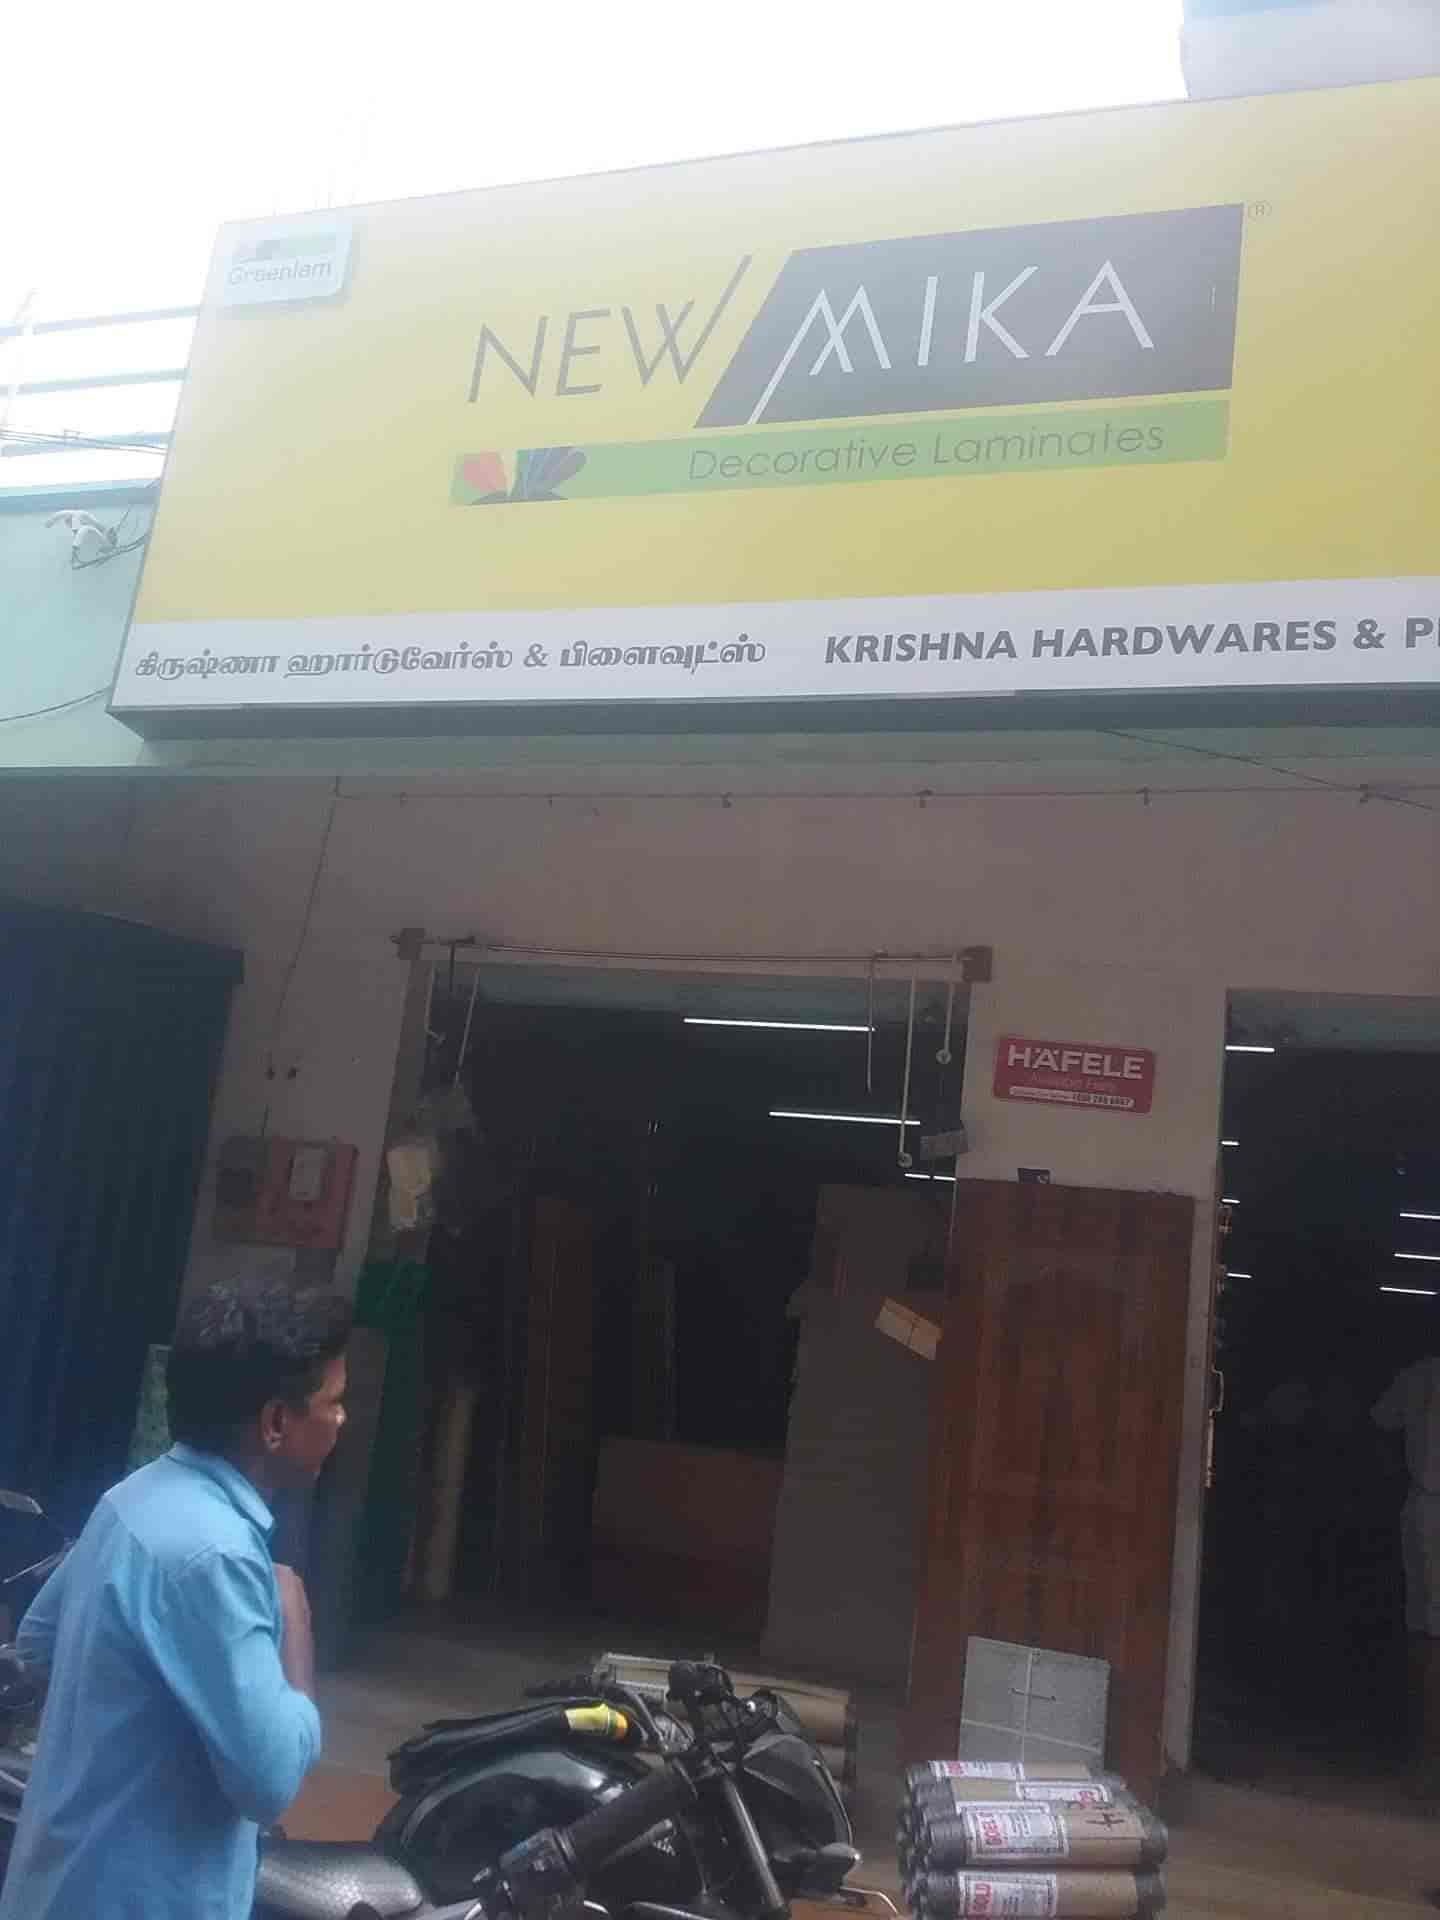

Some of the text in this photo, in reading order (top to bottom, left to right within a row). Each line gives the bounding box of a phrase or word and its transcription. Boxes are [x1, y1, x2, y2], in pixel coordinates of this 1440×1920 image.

[229, 259, 333, 286] Greenlam
[467, 254, 1155, 424] NEW MIKA
[689, 423, 1164, 480] Decorative Laminates
[135, 633, 767, 681] கிருஷ்ணா ஹார்டுவேர்ஸ் & பிளைவுட்ஸ்
[825, 617, 1440, 664] KRISHNA HARDWARES & P
[1008, 1044, 1145, 1080] HÄFELE
